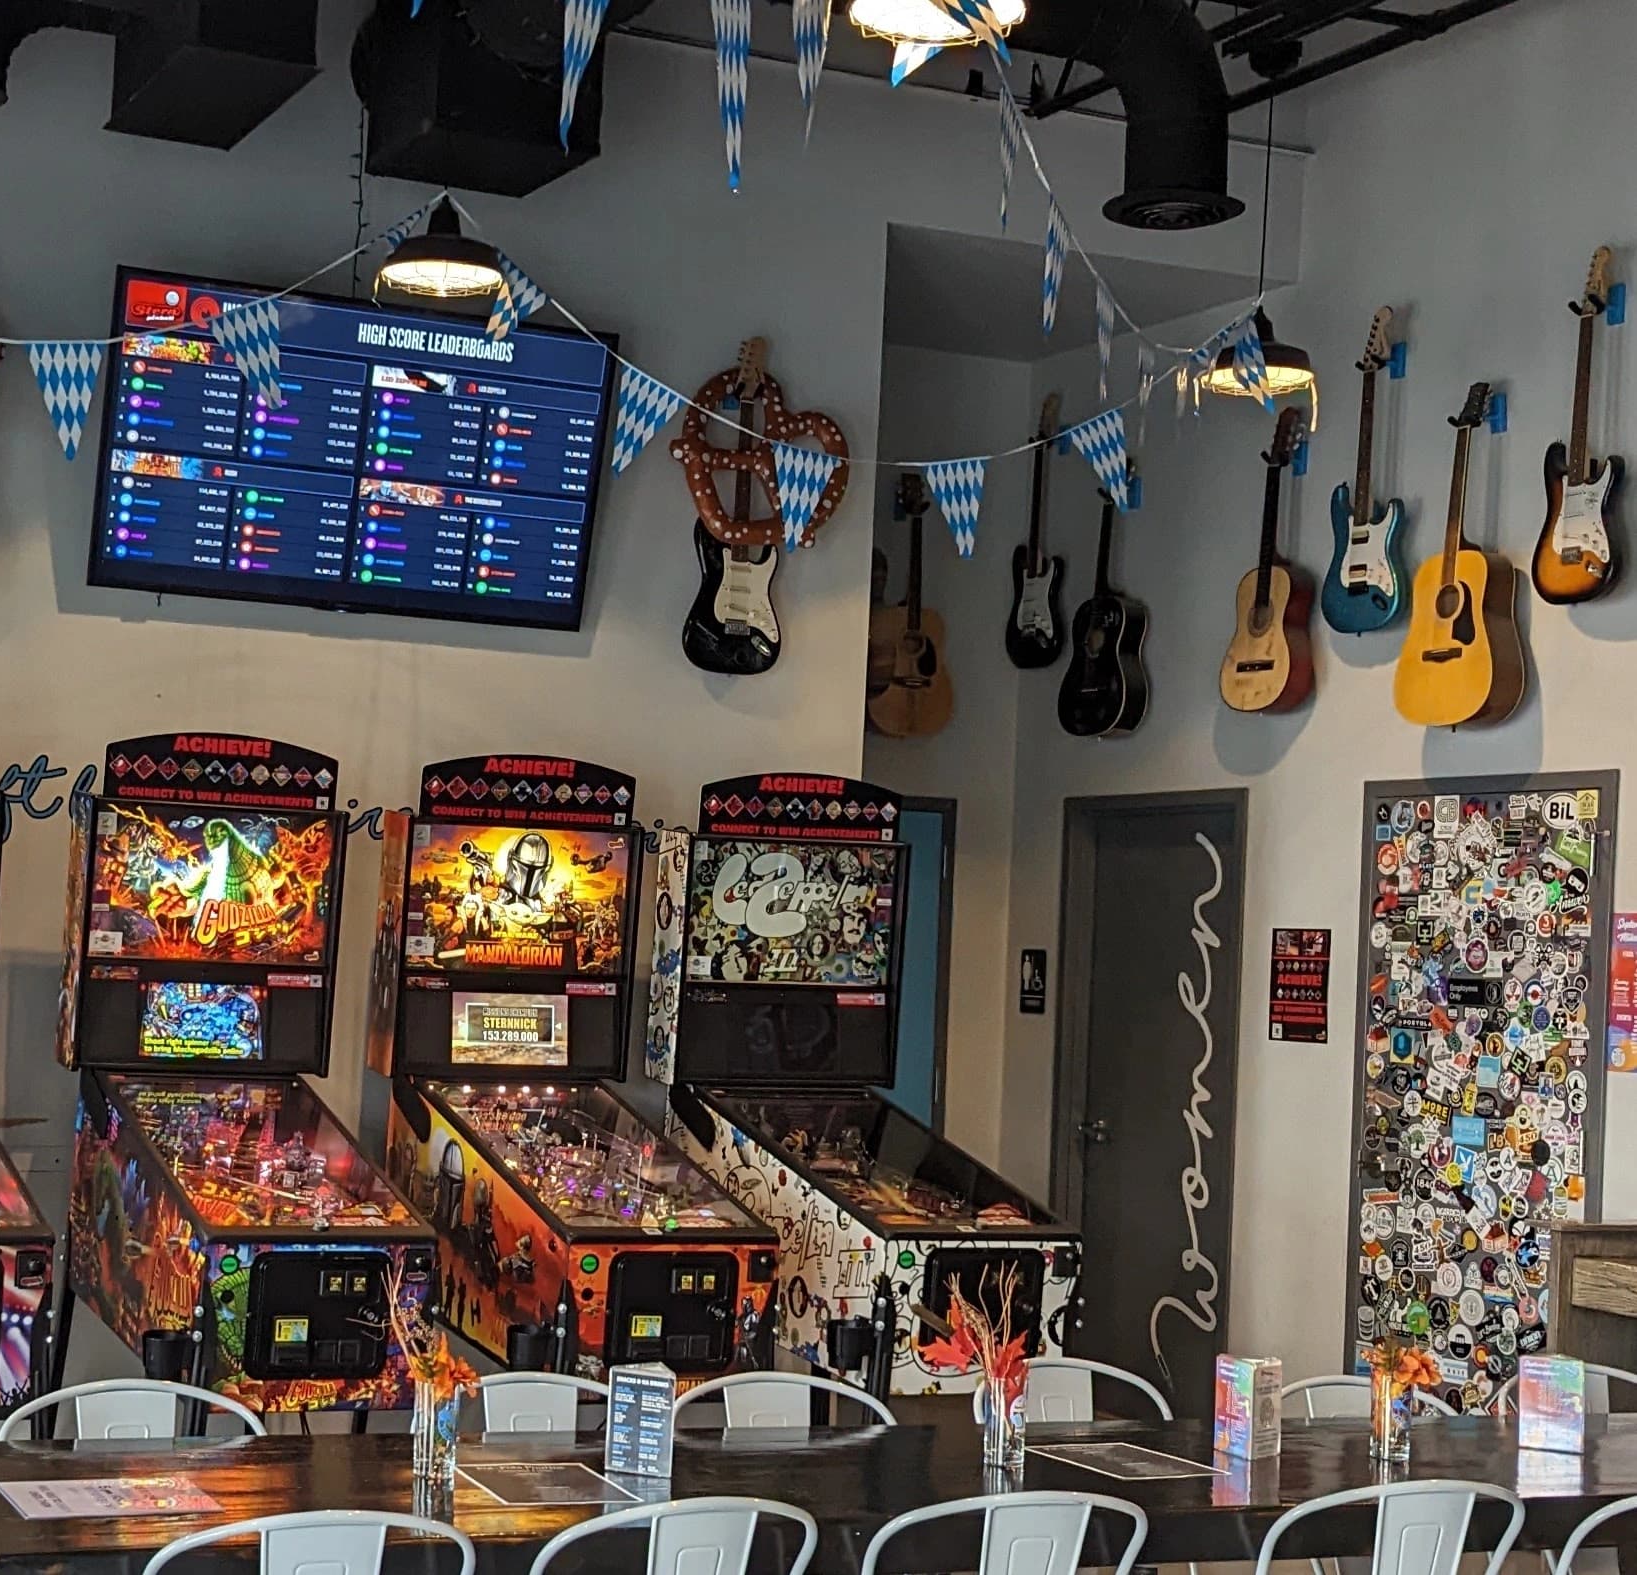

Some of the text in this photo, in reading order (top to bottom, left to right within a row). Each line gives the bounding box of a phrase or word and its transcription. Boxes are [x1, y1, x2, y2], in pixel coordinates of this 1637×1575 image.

[358, 322, 514, 363] HIGH SCORE LEADERBOARDS
[173, 735, 272, 759] ACHIEVE!
[484, 757, 576, 778] ACHIEVE!
[759, 776, 845, 795] ACHIEVE!
[118, 786, 314, 808] CONNECT TO WIN ACHIEVEMENTS
[432, 805, 613, 824] CONNECT TO WIN ACHIEVEMENTS
[1549, 802, 1574, 820] BiL
[711, 823, 879, 839] CONNECT TO WIN ACHIEVEMENTS
[196, 898, 276, 945] GODZILLA
[465, 943, 562, 966] MANDALORIAN
[1422, 1100, 1449, 1117] MORE
